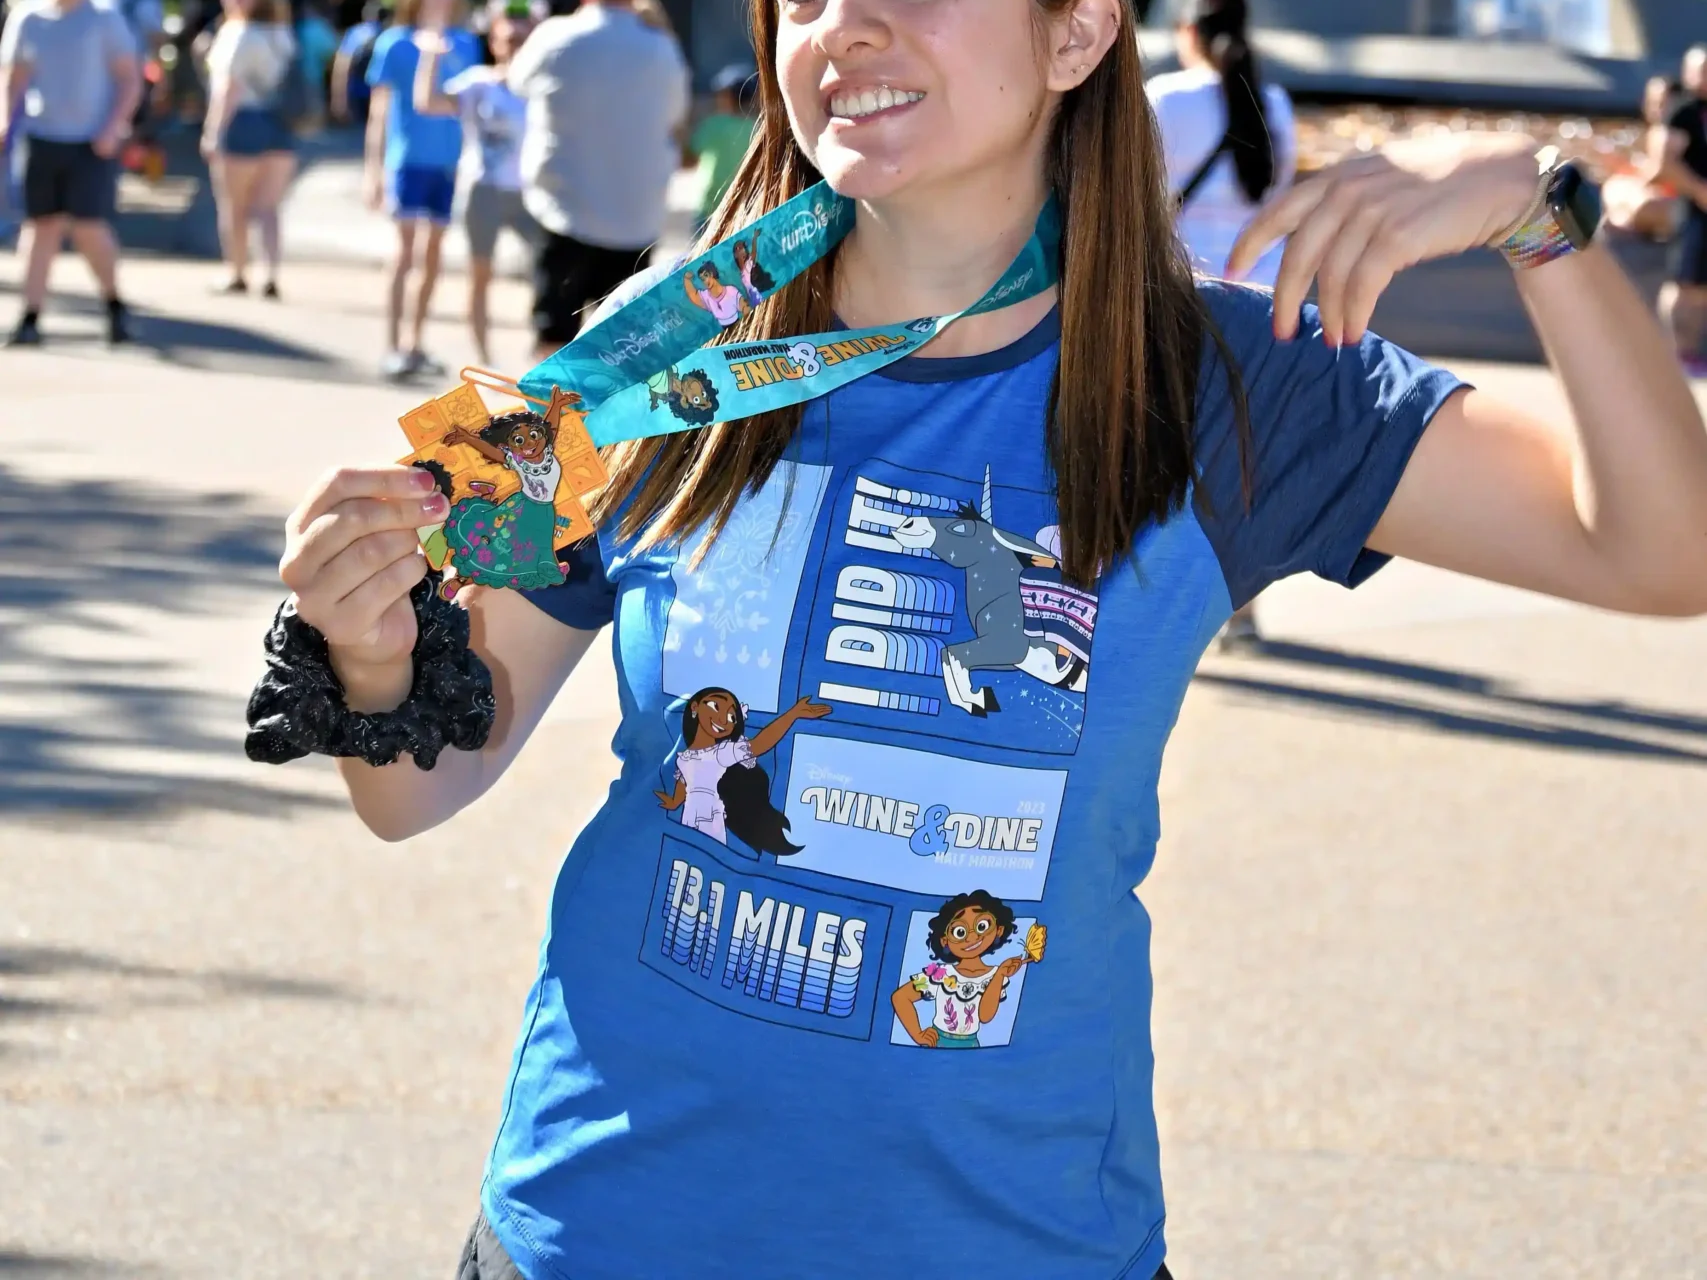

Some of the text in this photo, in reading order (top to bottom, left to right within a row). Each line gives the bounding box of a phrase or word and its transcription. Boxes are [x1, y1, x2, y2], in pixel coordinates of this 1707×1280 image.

[722, 343, 791, 362] HALF MARATHON
[814, 333, 908, 368] WINE
[728, 355, 805, 392] DINE
[799, 785, 921, 840] WINE
[943, 811, 1044, 853] DINE
[1016, 799, 1046, 816] 2023
[933, 850, 1036, 872] HALF MARATHON
[731, 889, 869, 970] MILES
